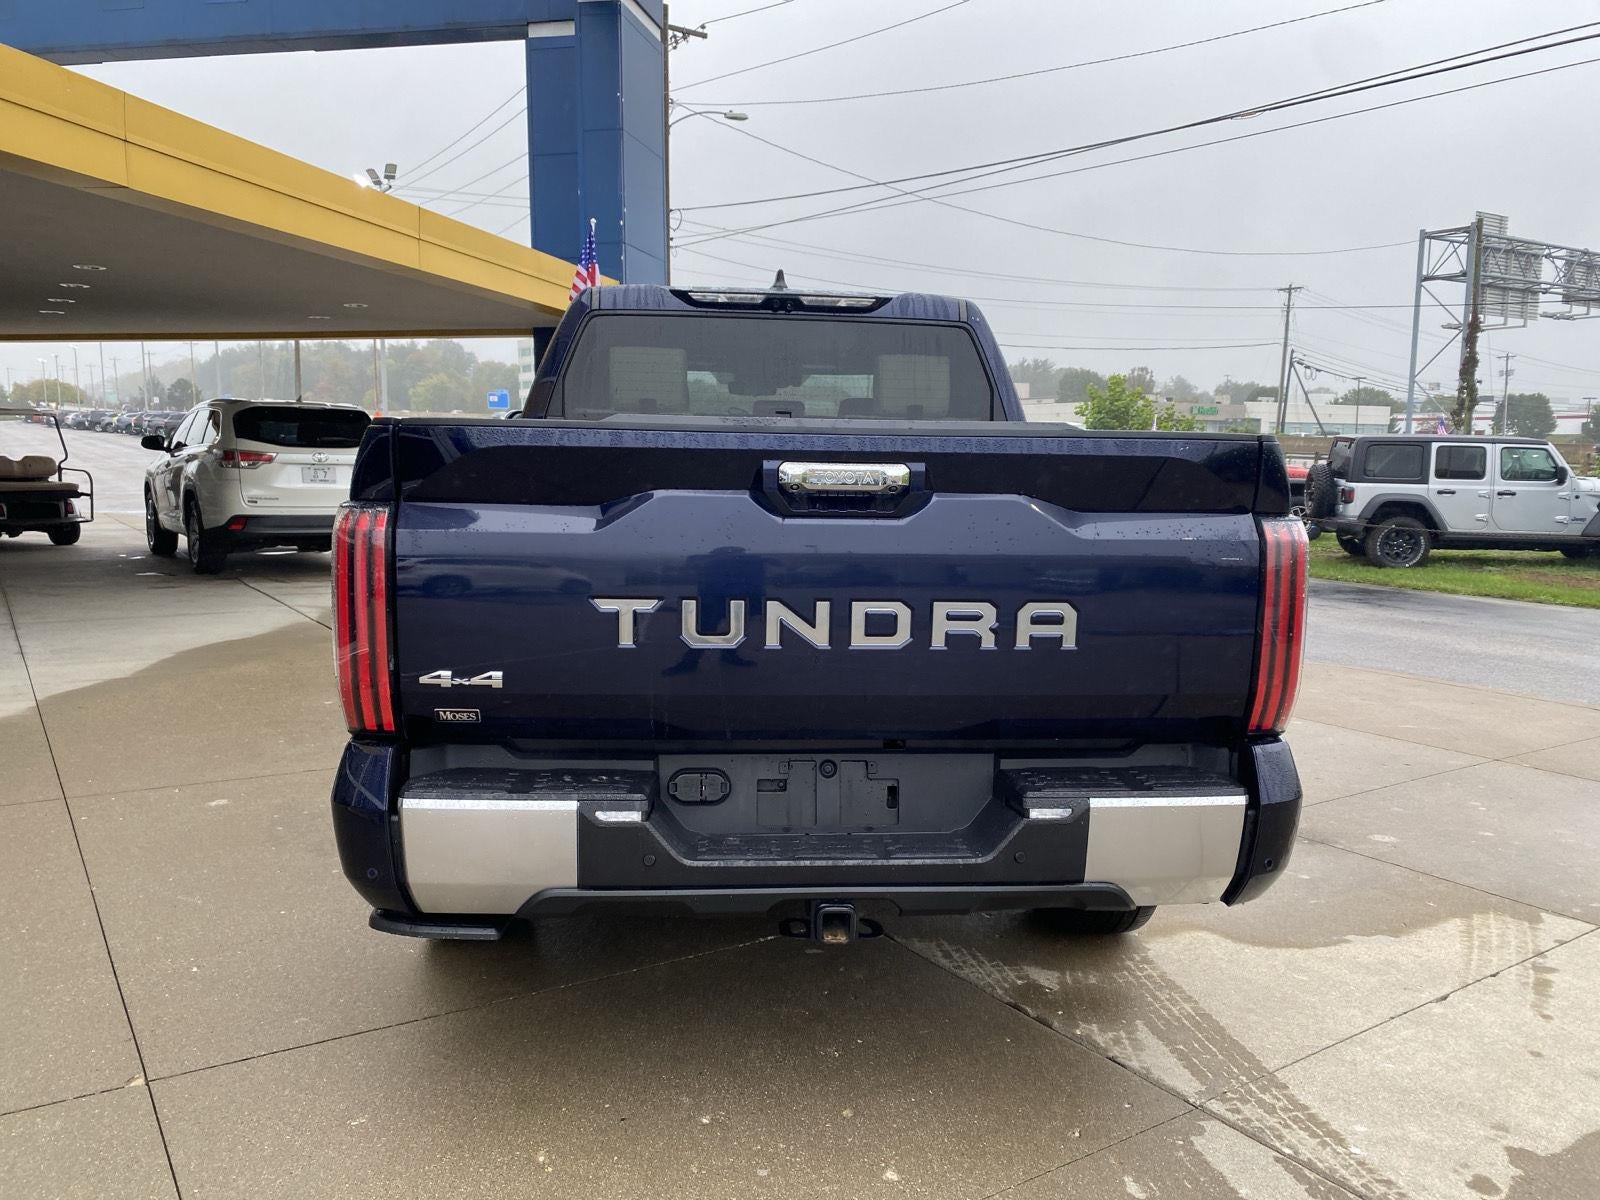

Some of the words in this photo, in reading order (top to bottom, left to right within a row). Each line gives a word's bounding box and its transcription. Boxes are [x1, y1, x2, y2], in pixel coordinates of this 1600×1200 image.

[815, 471, 875, 485] TOYOTA
[592, 598, 1078, 650] TUNDRA
[439, 711, 477, 721] MOSES
